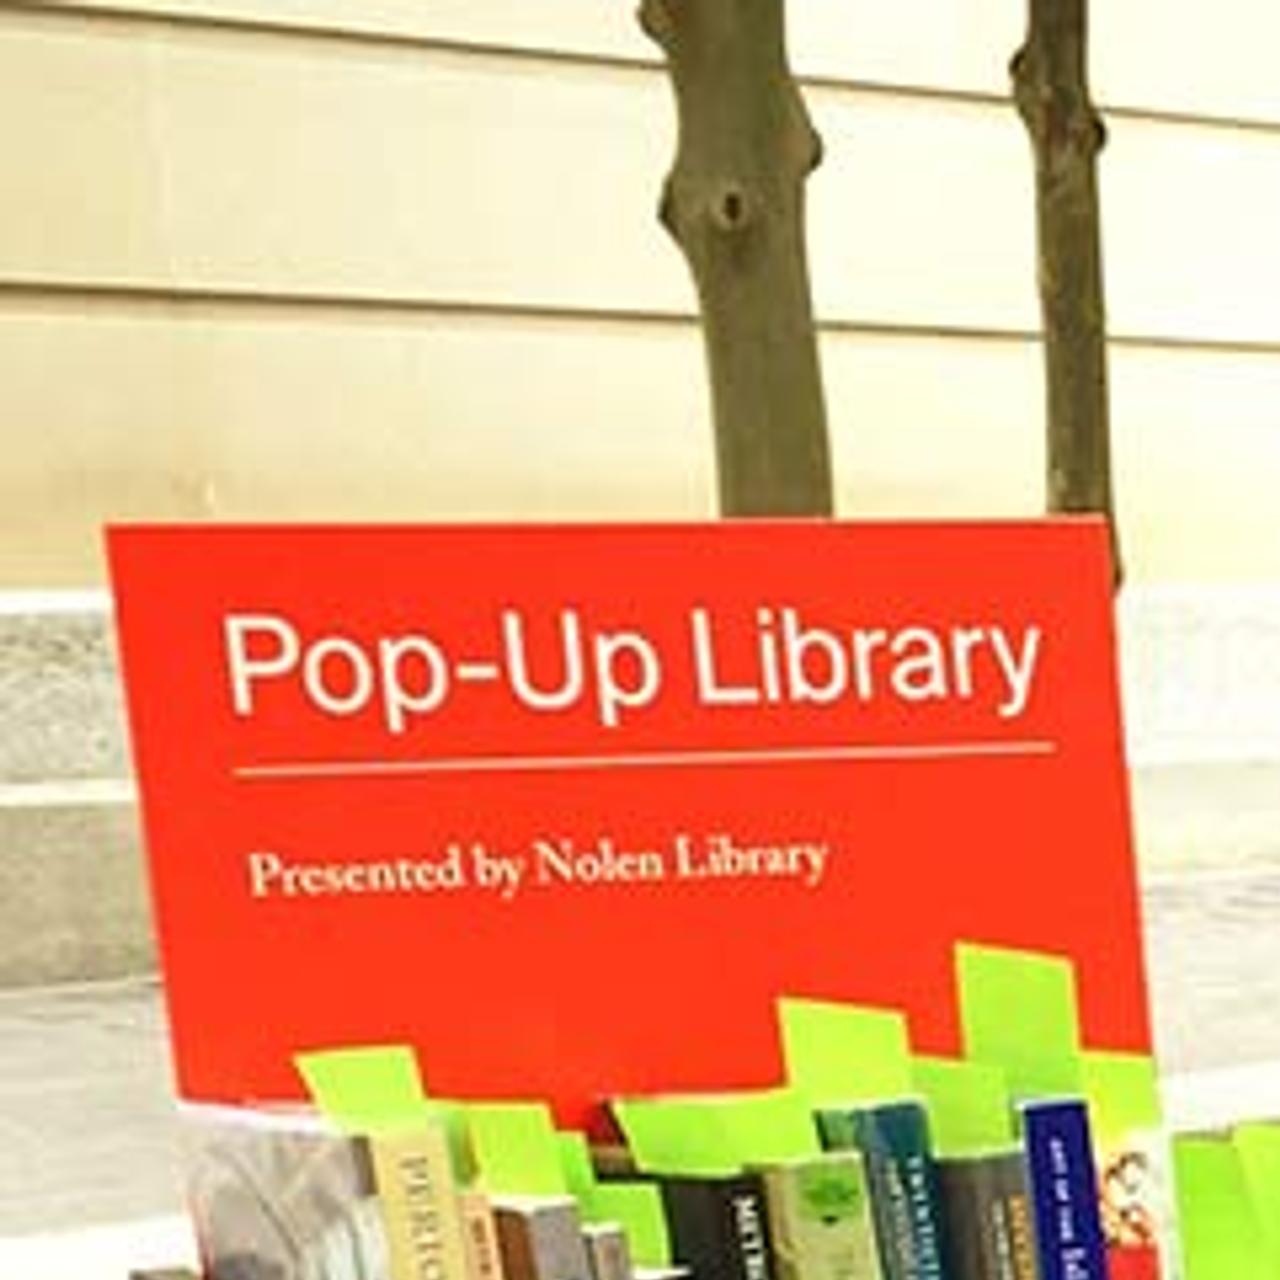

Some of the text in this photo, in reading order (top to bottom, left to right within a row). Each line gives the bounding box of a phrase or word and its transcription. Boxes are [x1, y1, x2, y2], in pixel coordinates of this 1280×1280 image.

[224, 608, 1041, 733] Pop-Up Library
[248, 834, 830, 899] Presented by Nolen Library
